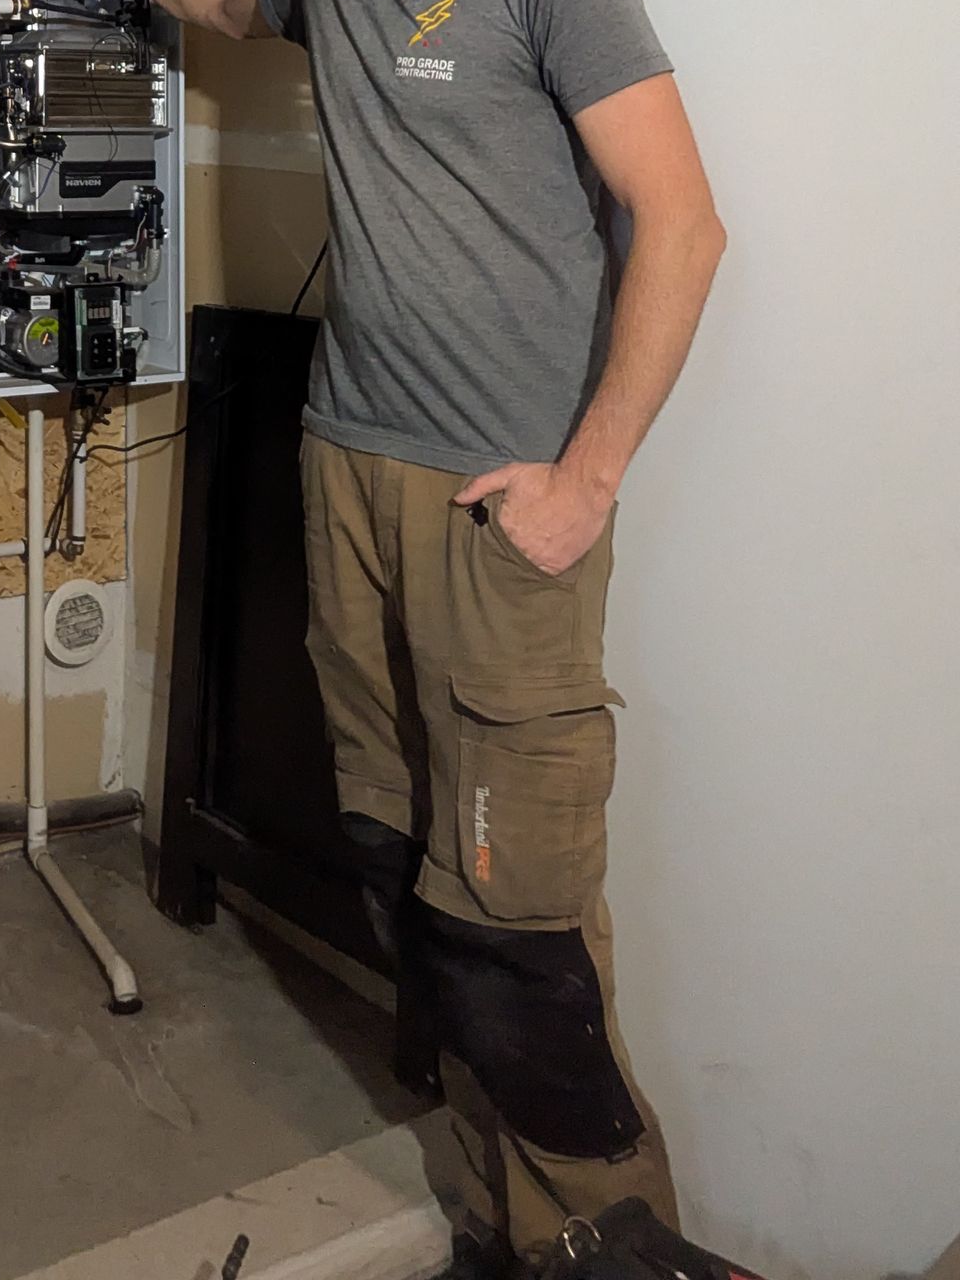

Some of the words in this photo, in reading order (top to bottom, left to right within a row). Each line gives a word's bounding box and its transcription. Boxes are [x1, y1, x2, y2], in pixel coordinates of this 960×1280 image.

[396, 56, 416, 67] PRO
[417, 58, 455, 71] GRADE
[395, 67, 453, 81] CONTRACTING
[475, 785, 490, 848] Timberland
